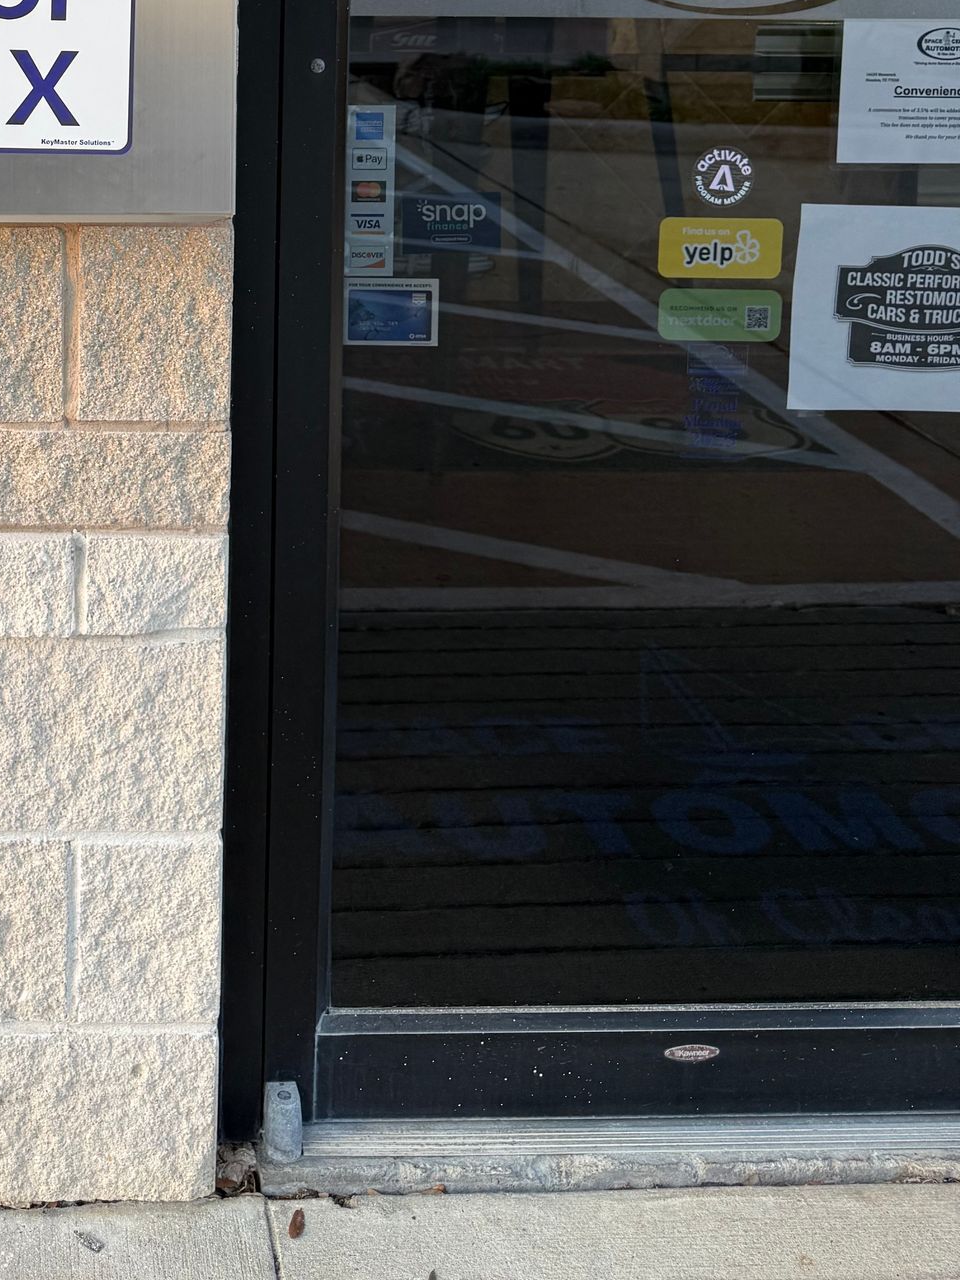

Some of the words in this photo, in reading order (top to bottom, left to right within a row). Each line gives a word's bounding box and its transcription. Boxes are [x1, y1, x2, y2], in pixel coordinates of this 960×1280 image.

[41, 138, 78, 146] KeyMaster
[365, 153, 383, 166] Pay
[696, 149, 753, 176] activate
[695, 175, 723, 205] PROGRAM
[724, 180, 752, 206] MEMBER
[421, 203, 487, 228] snap
[355, 220, 381, 229] VISA
[426, 221, 469, 231] finance
[682, 227, 704, 235] Find
[351, 251, 384, 259] DISCOVER
[685, 241, 733, 265] yelp
[847, 272, 904, 287] CLASSIC
[668, 314, 736, 327] nextdoor
[867, 304, 906, 322] CARS
[909, 309, 920, 324] &
[886, 333, 926, 342] BUSINESS
[927, 334, 954, 342] HOURS
[869, 341, 911, 354] 8AM
[875, 355, 919, 363] MONDAY
